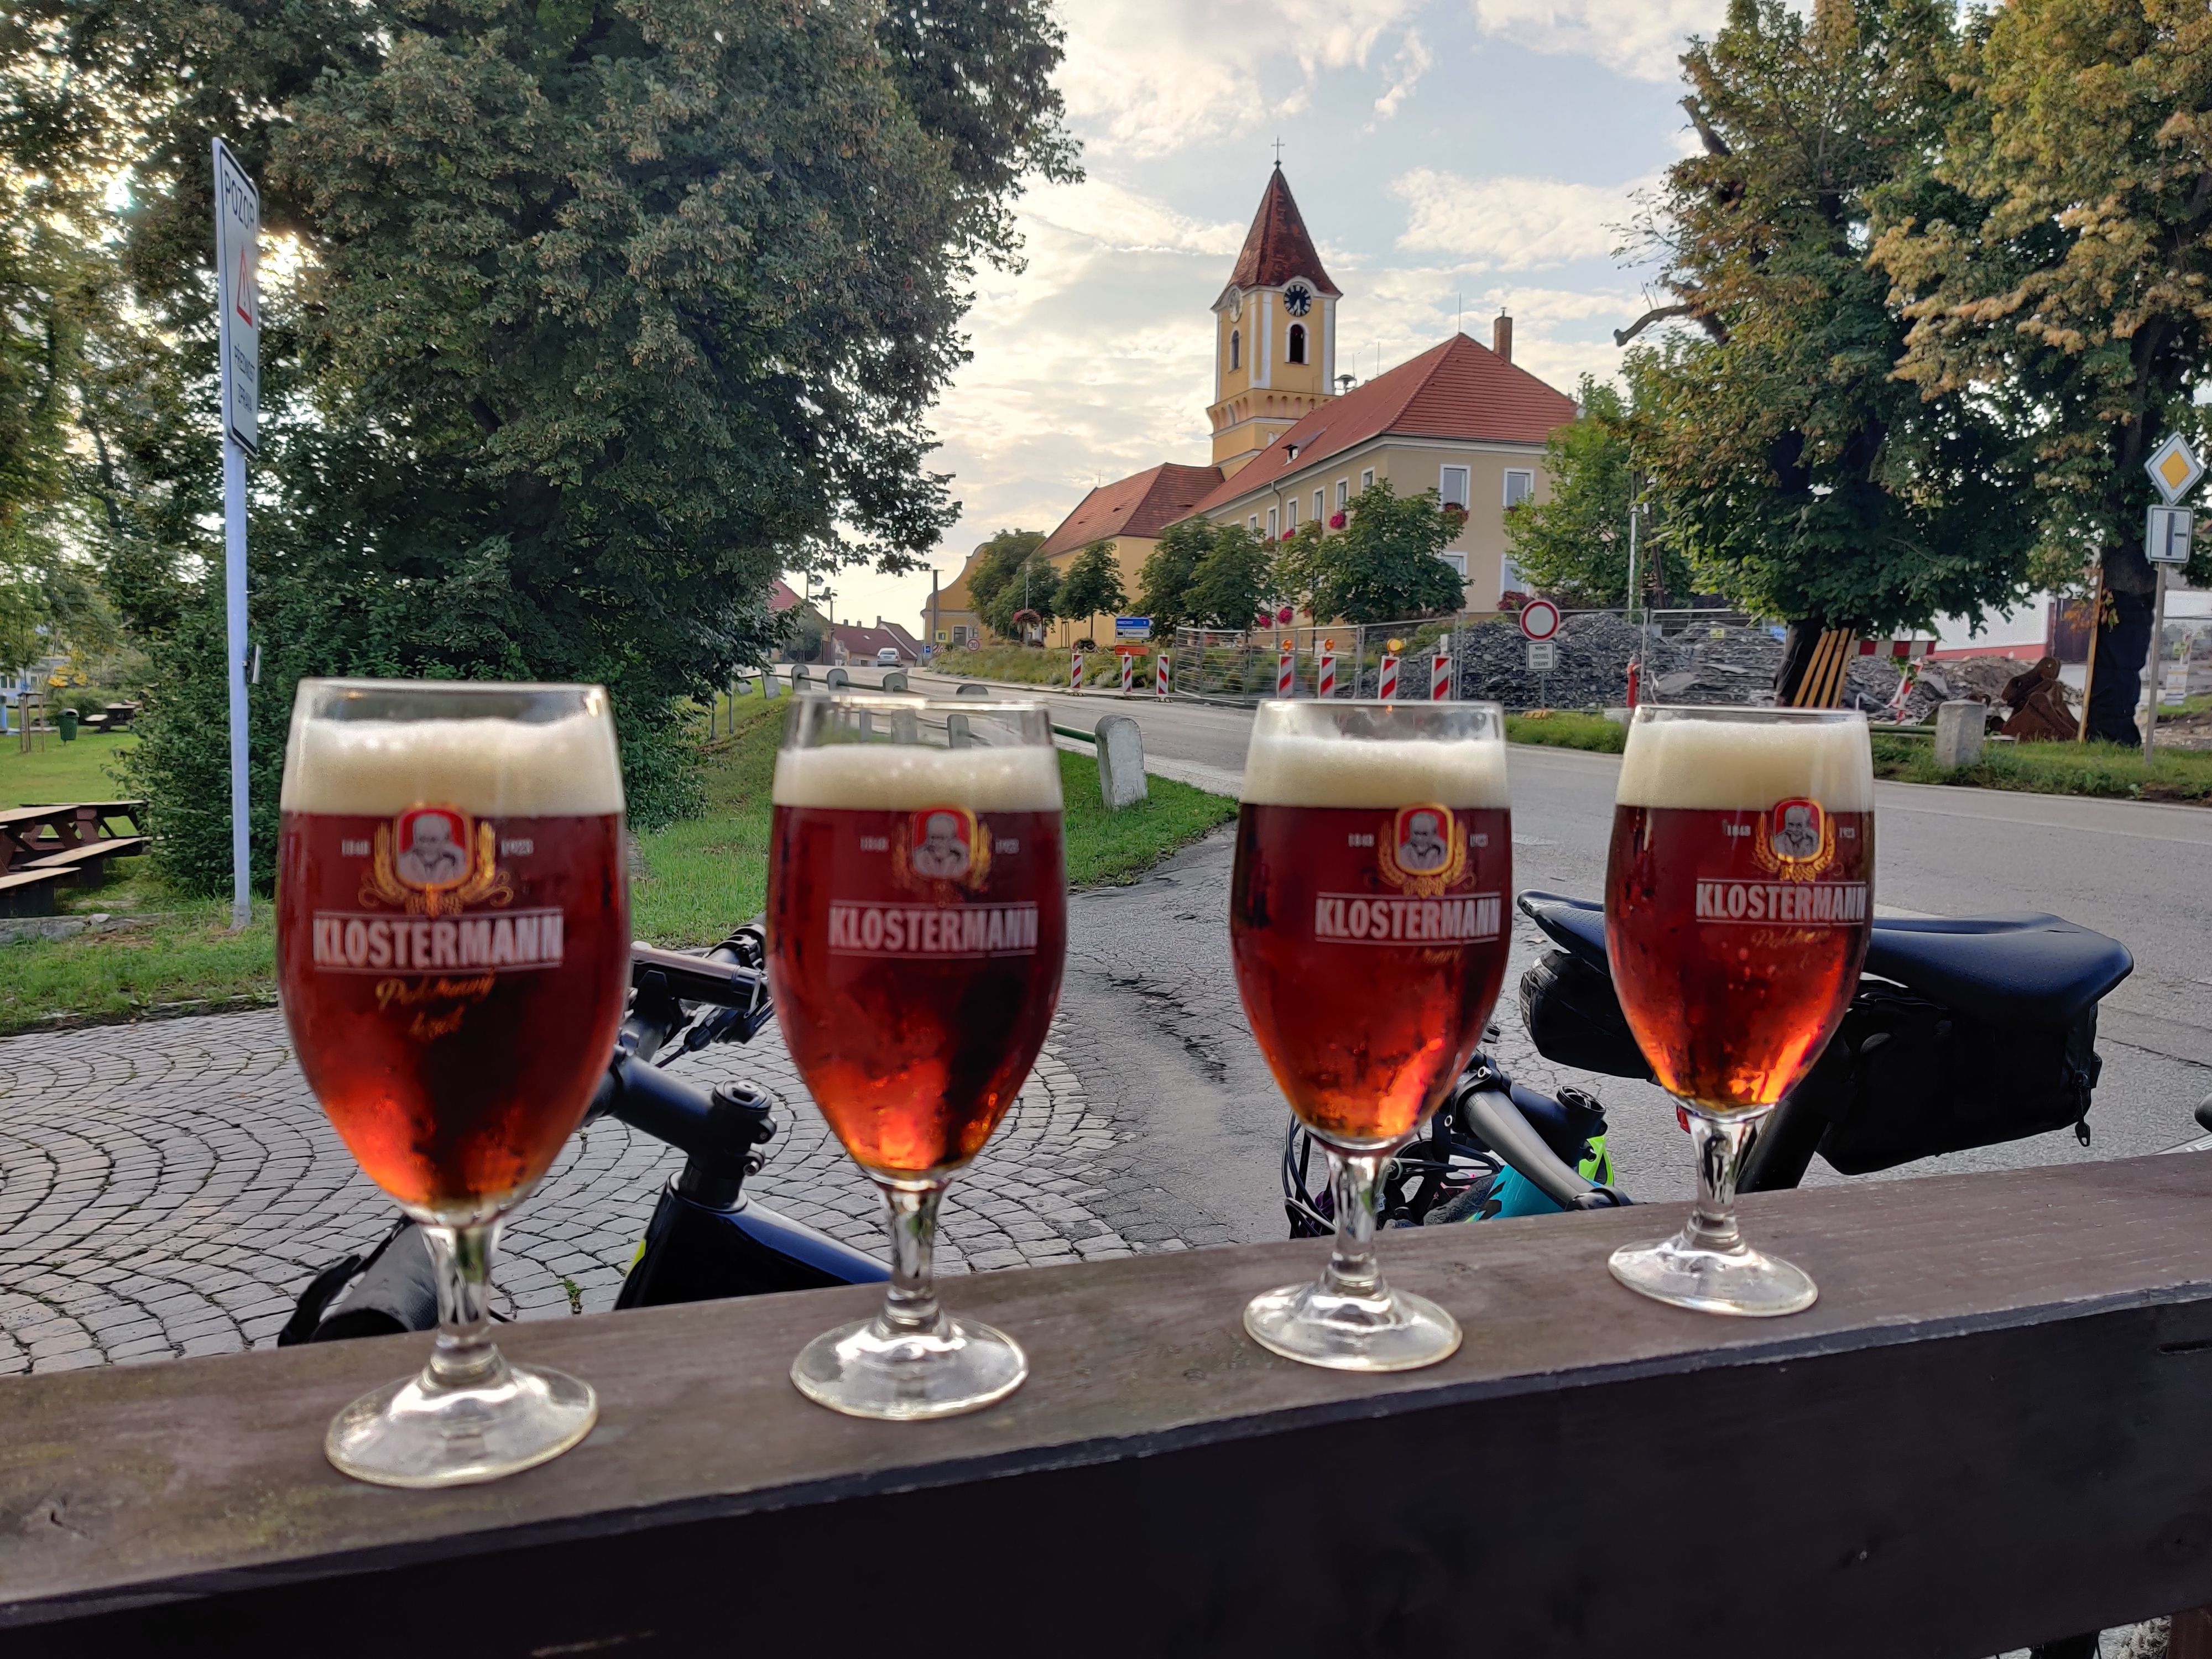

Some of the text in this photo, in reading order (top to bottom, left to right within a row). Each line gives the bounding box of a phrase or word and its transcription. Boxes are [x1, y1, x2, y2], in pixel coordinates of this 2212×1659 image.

[225, 169, 255, 233] POZOR
[1315, 897, 1501, 940] KLOSTERMANN
[1695, 884, 1866, 921] KLOSTERMANN
[313, 916, 564, 969] KLOSTERMANN
[830, 905, 1039, 952] KLOSTERMANN
